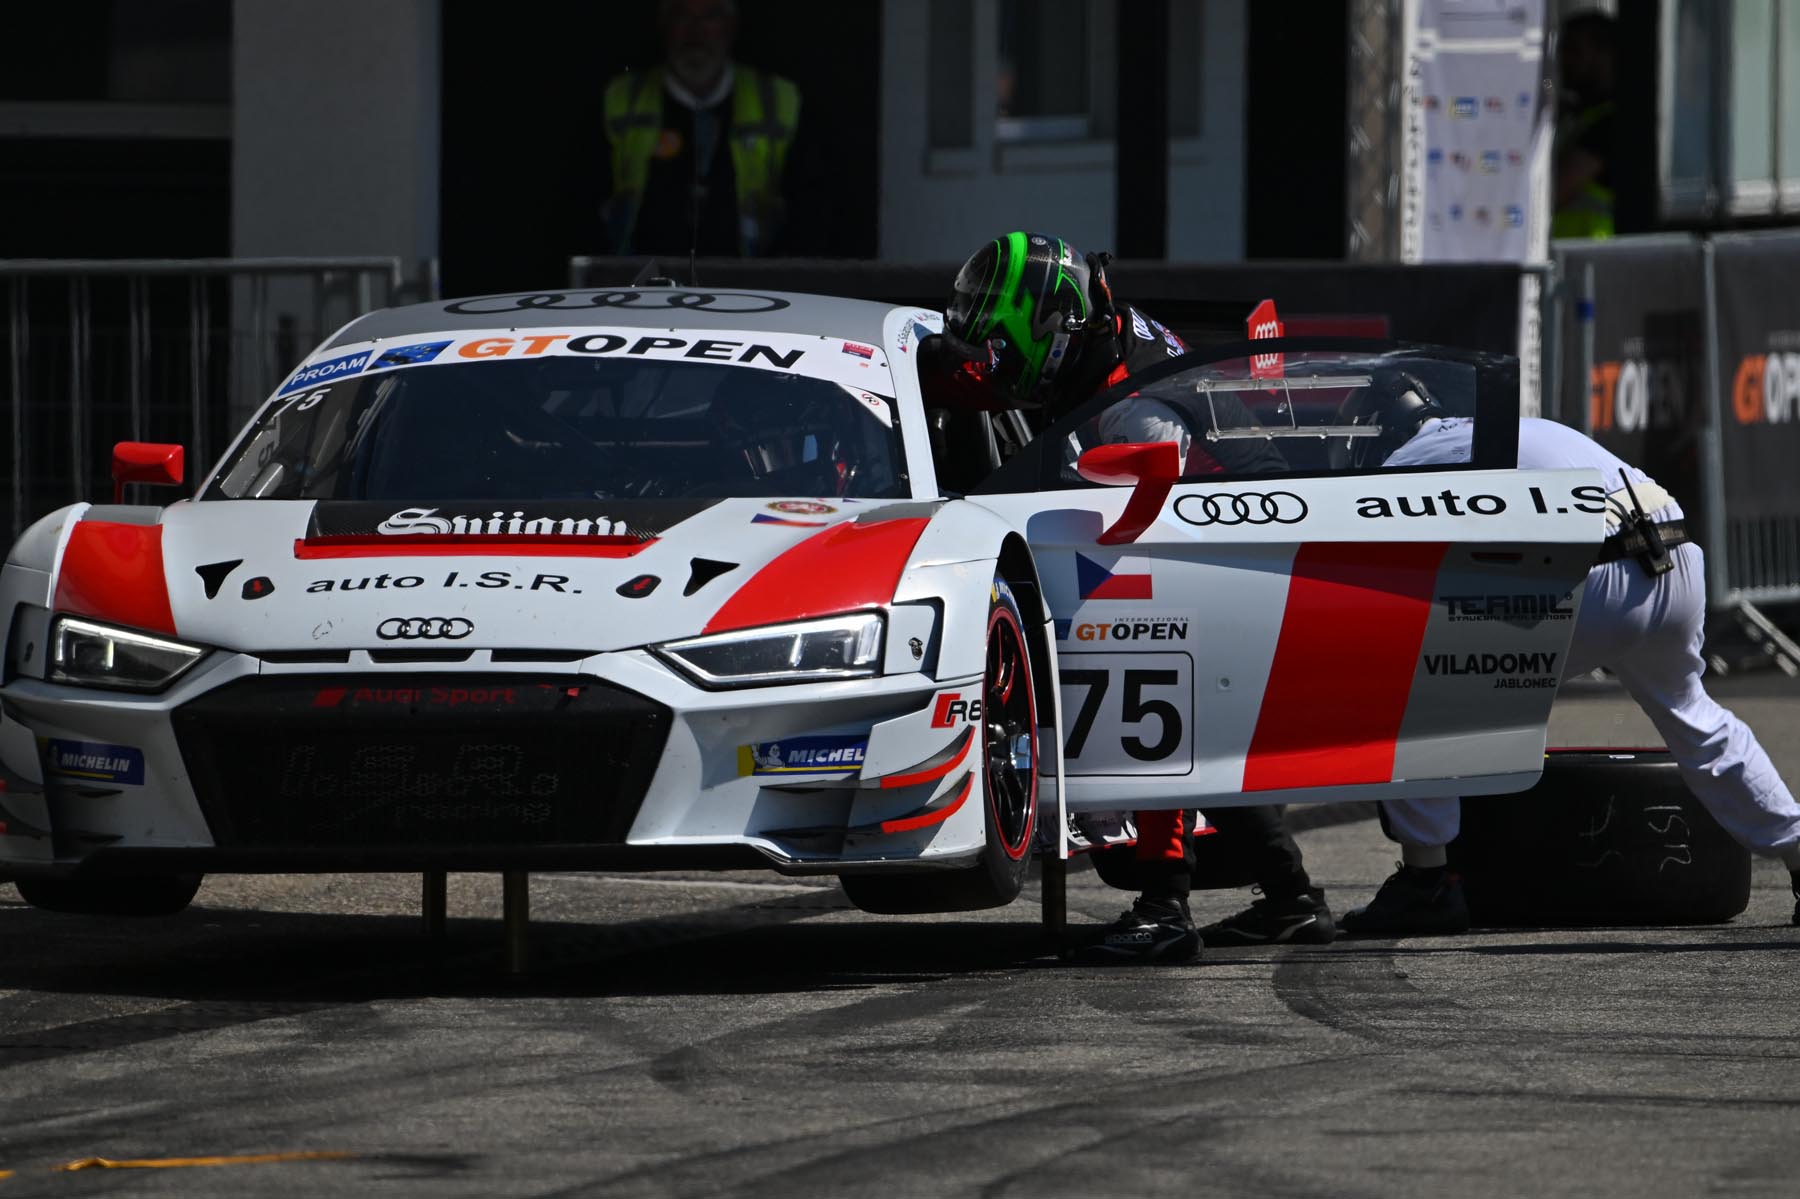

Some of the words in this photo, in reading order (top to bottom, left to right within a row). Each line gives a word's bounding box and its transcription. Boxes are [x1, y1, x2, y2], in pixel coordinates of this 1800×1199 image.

[290, 355, 366, 386] PROAM
[273, 388, 332, 417] 75
[1355, 489, 1507, 518] auto
[306, 573, 425, 593] auto
[443, 572, 583, 594] I.S.R.
[1424, 652, 1557, 676] VILADOMY
[353, 685, 422, 703] Audi
[430, 686, 516, 706] Sport
[1493, 678, 1557, 689] JABLONEC
[946, 699, 982, 723] R8
[1059, 669, 1183, 762] 75
[62, 753, 130, 772] MICHELIN
